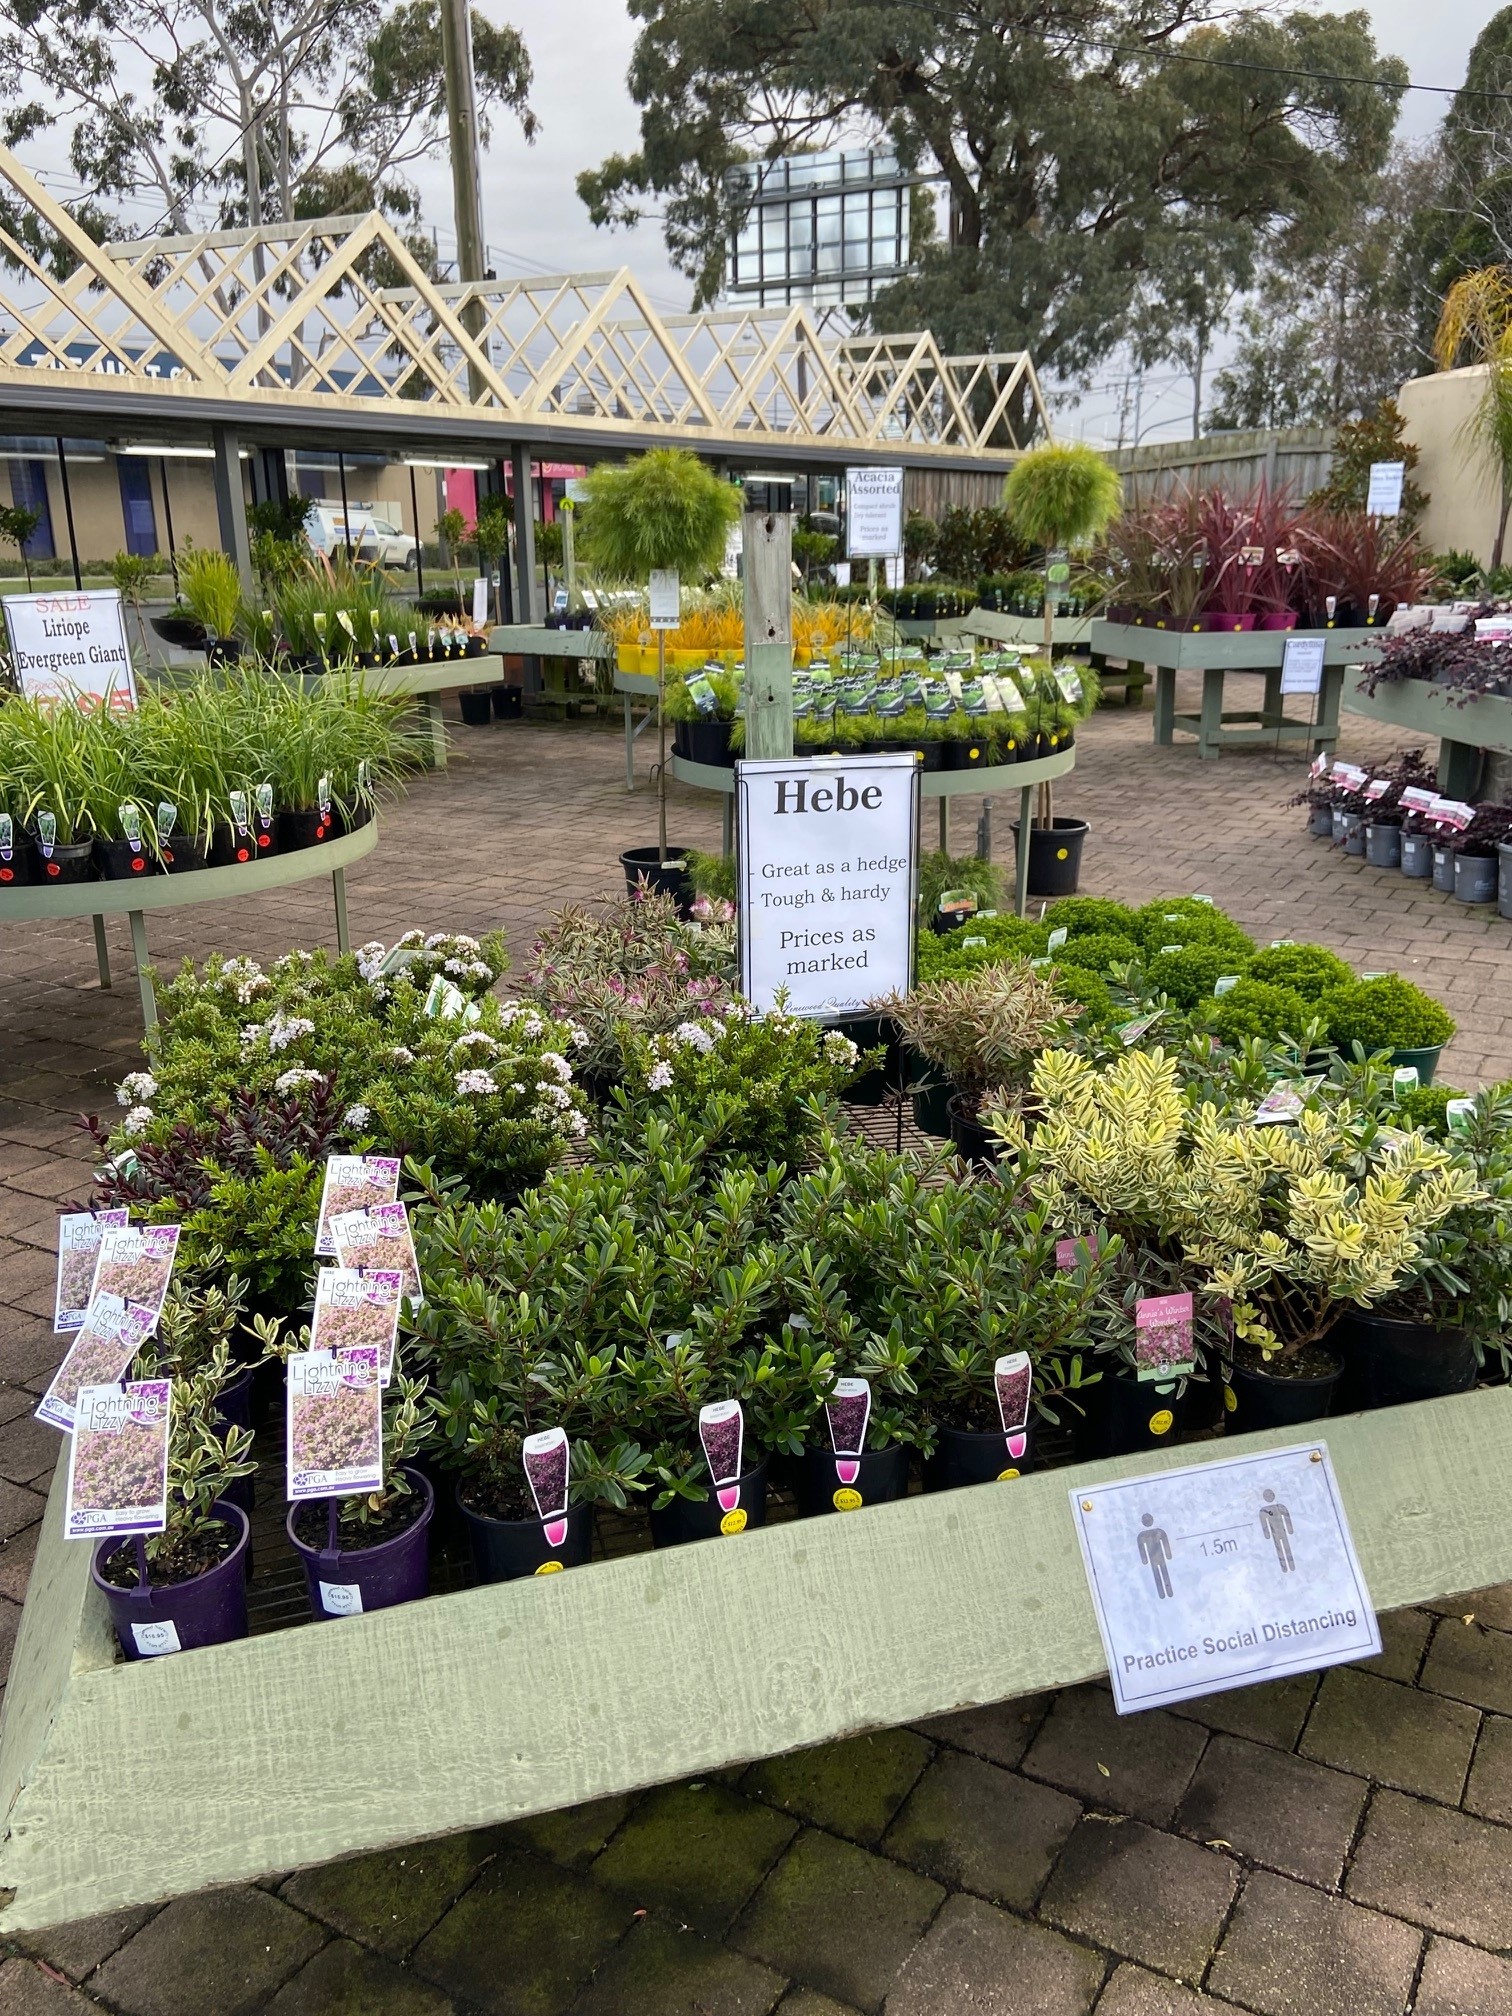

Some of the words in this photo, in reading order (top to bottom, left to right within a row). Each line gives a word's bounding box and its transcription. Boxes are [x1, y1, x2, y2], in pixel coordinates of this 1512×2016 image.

[854, 471, 895, 482] Acacia
[850, 483, 900, 494] Assorted
[36, 595, 92, 614] SALE
[42, 618, 91, 640] Liriope
[17, 650, 86, 672] Evergreen
[89, 644, 127, 664] Giant
[773, 776, 882, 815] Hebe
[762, 863, 810, 878] Great
[816, 862, 835, 874] as
[841, 862, 851, 873] a
[857, 855, 907, 873] hedge
[761, 890, 815, 908] Tough
[821, 888, 835, 902] &
[840, 884, 891, 901] hardy
[780, 928, 844, 949] Prices
[852, 927, 876, 942] as
[786, 950, 869, 975] marked
[827, 997, 861, 1009] Quality
[330, 1163, 391, 1180] Lightning
[338, 1174, 365, 1188] Lizzy
[335, 1215, 399, 1237] Lightning
[72, 1238, 98, 1250] Lizzy
[105, 1236, 168, 1254] Lightning
[347, 1231, 377, 1247] Lizzy
[111, 1249, 141, 1264] Lizzy
[322, 1277, 391, 1297] Lightning
[330, 1293, 363, 1309] Lizzy
[93, 1302, 141, 1337] Lightning
[1136, 1308, 1164, 1319] Annie's
[1165, 1305, 1190, 1315] Winter
[92, 1319, 117, 1343] Lizzy
[1149, 1317, 1178, 1327] Wonder
[293, 1361, 368, 1384] Lightning
[303, 1379, 339, 1397] Lizzy
[81, 1397, 158, 1418] Lightning
[90, 1413, 126, 1433] Lizzy
[308, 1475, 327, 1484] PGA
[87, 1514, 106, 1523] PGA
[1199, 1537, 1238, 1557] 1.5m
[1123, 1643, 1199, 1673] Practice
[1202, 1627, 1259, 1655] Social
[1261, 1608, 1357, 1643] Distancing
